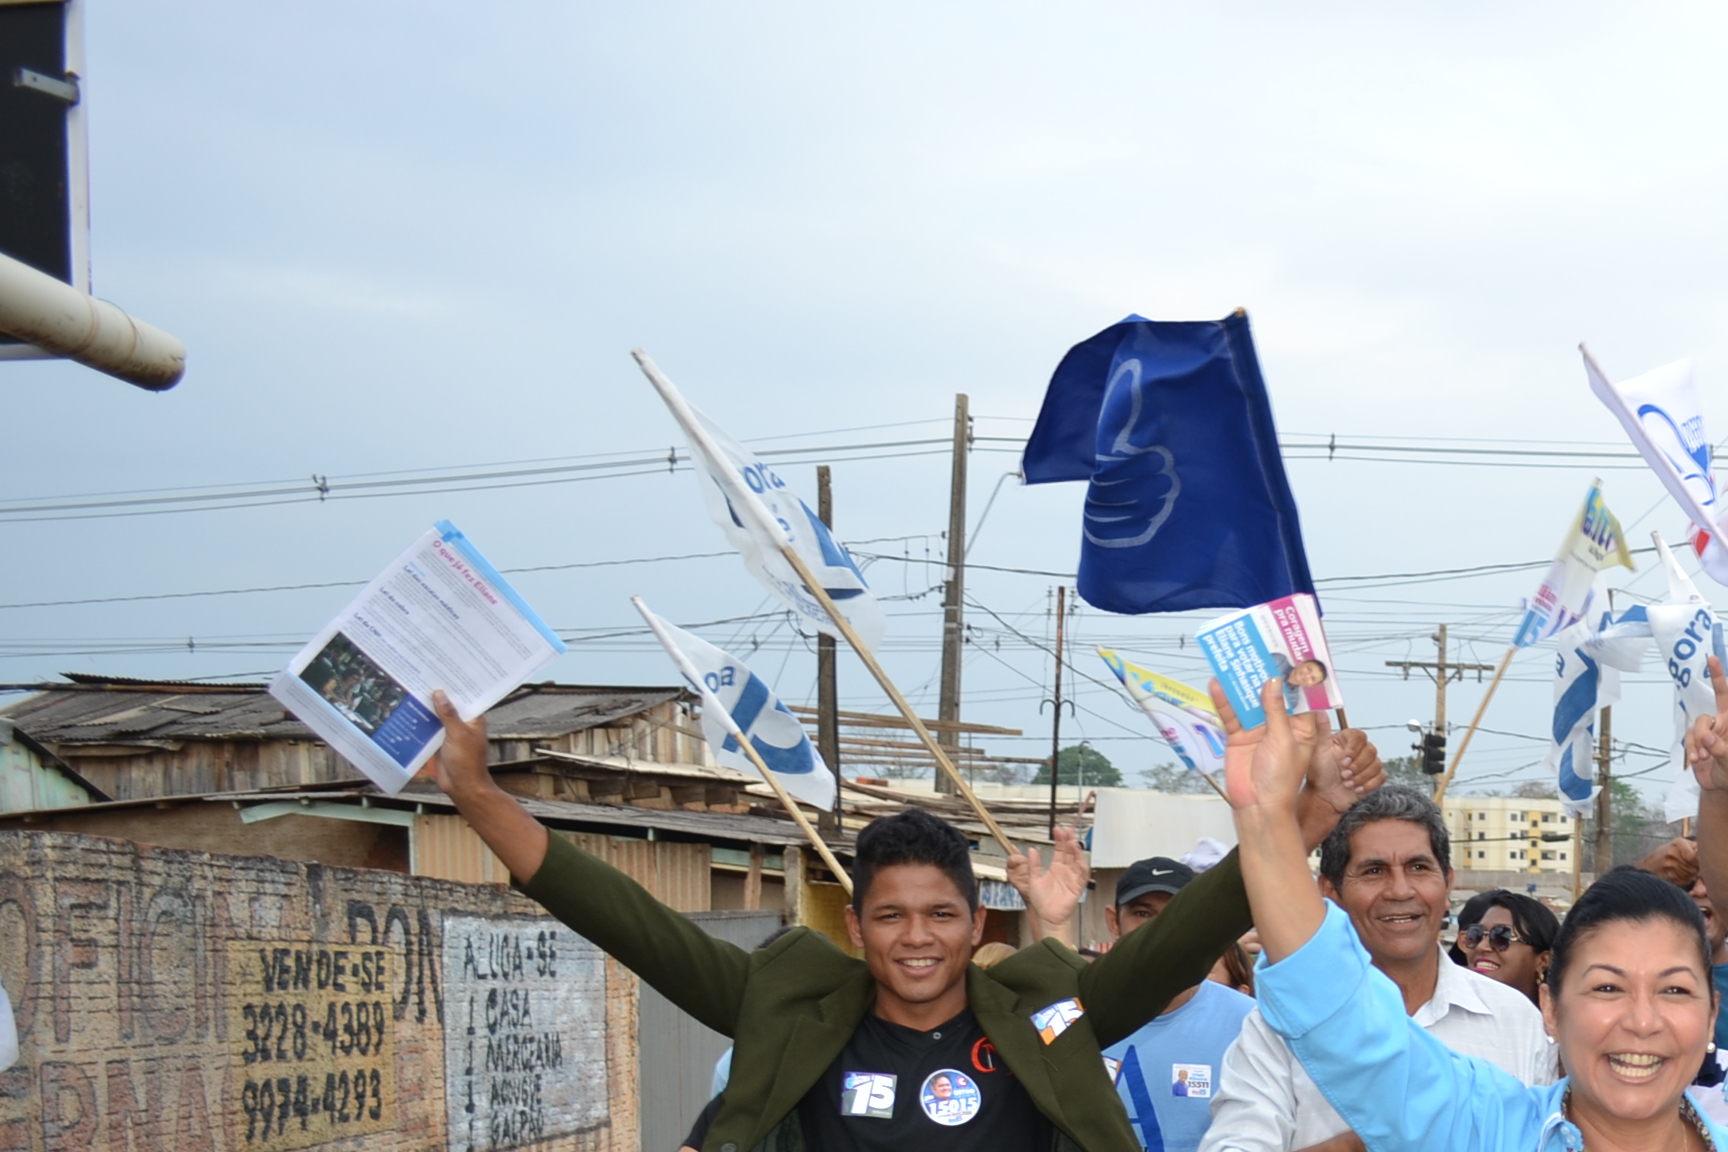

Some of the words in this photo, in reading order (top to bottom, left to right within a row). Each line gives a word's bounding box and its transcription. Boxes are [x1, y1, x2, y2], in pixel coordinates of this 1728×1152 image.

[1203, 634, 1229, 672] prefeita
[1225, 625, 1241, 649] para
[1237, 646, 1255, 677] votar
[1234, 620, 1251, 646] Bons
[1274, 609, 1289, 627] pra
[1284, 626, 1303, 661] mudar
[1285, 606, 1309, 653] Coragem
[1215, 628, 1235, 660] Eliane
[1229, 659, 1260, 709] Sinhasique
[259, 947, 386, 993] VENDE-SE
[463, 931, 558, 982] ALUGA-SE
[241, 1000, 385, 1065] 3228-4389
[486, 988, 533, 1036] CASA
[851, 1075, 896, 1114] 15
[929, 1097, 978, 1116] 15015
